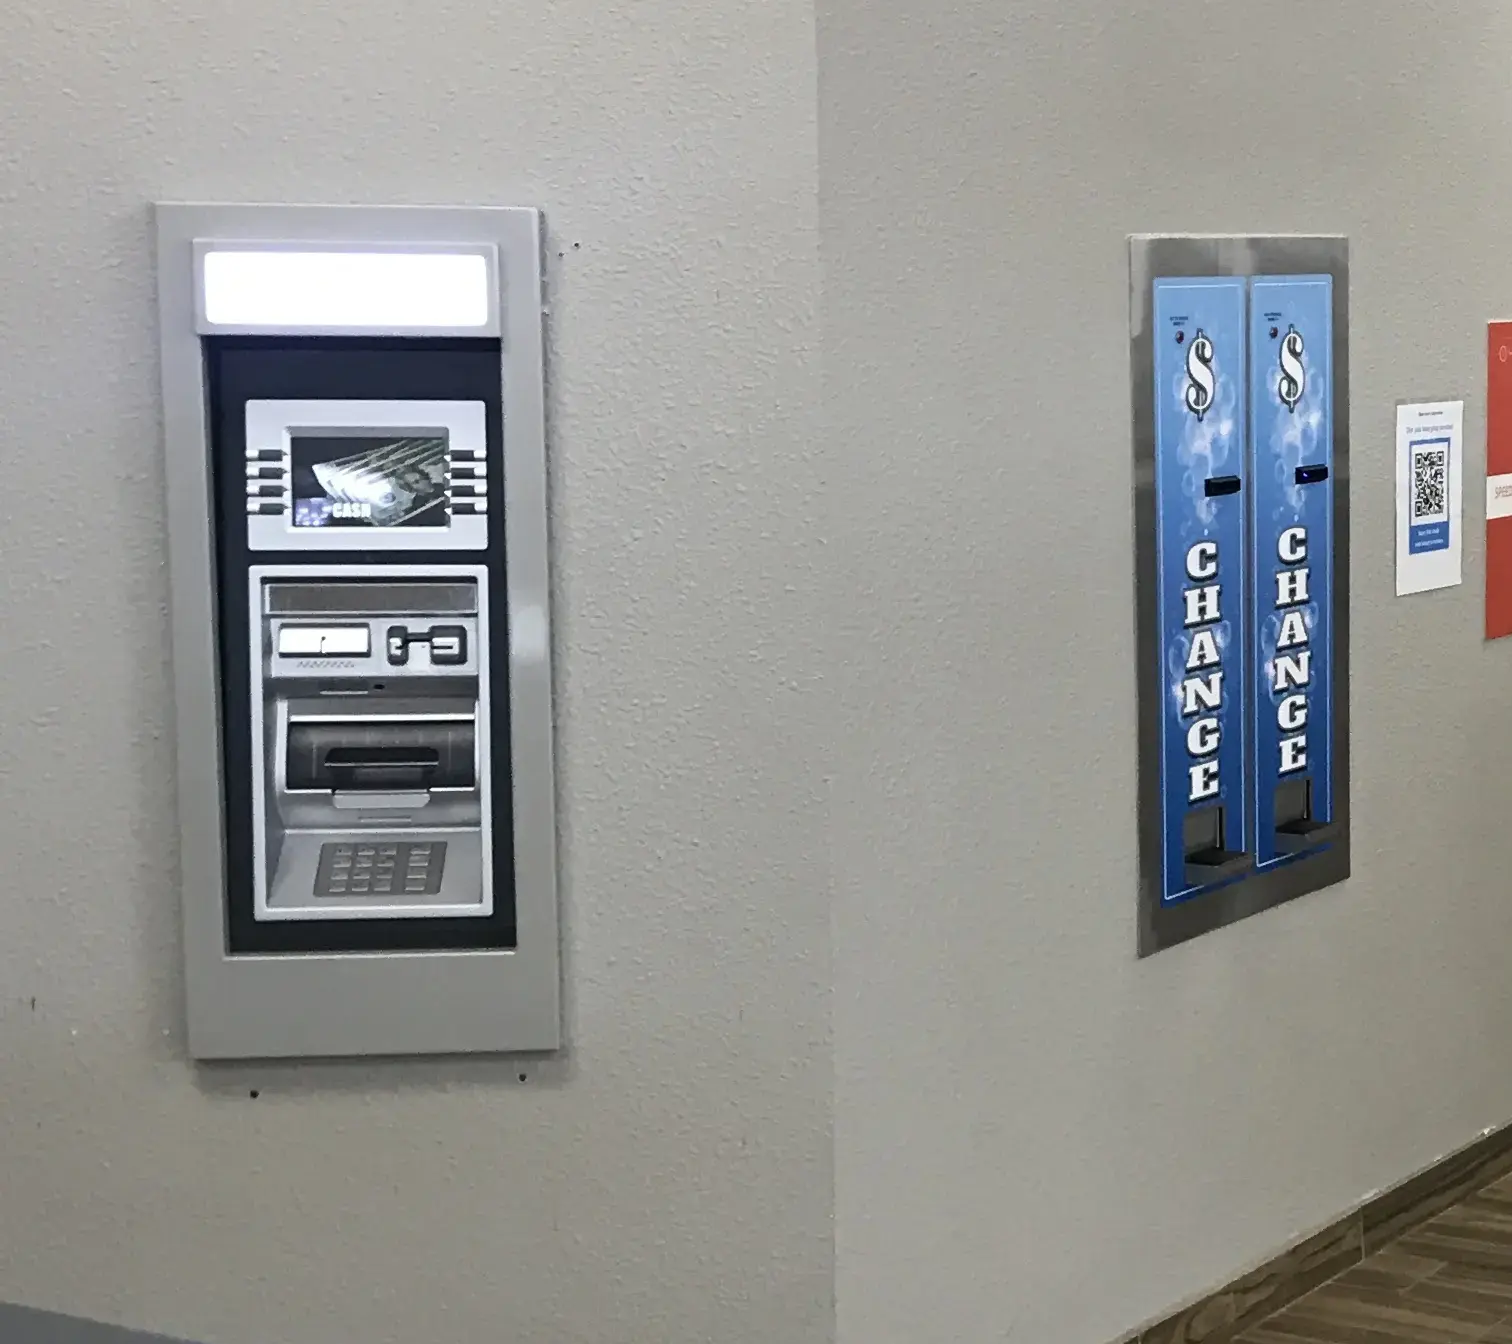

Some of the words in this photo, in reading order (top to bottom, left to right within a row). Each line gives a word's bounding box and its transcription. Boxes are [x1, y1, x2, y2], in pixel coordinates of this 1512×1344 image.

[332, 502, 371, 518] CASH
[1183, 541, 1224, 804] CHANGE
[1274, 526, 1312, 778] CHANGE
